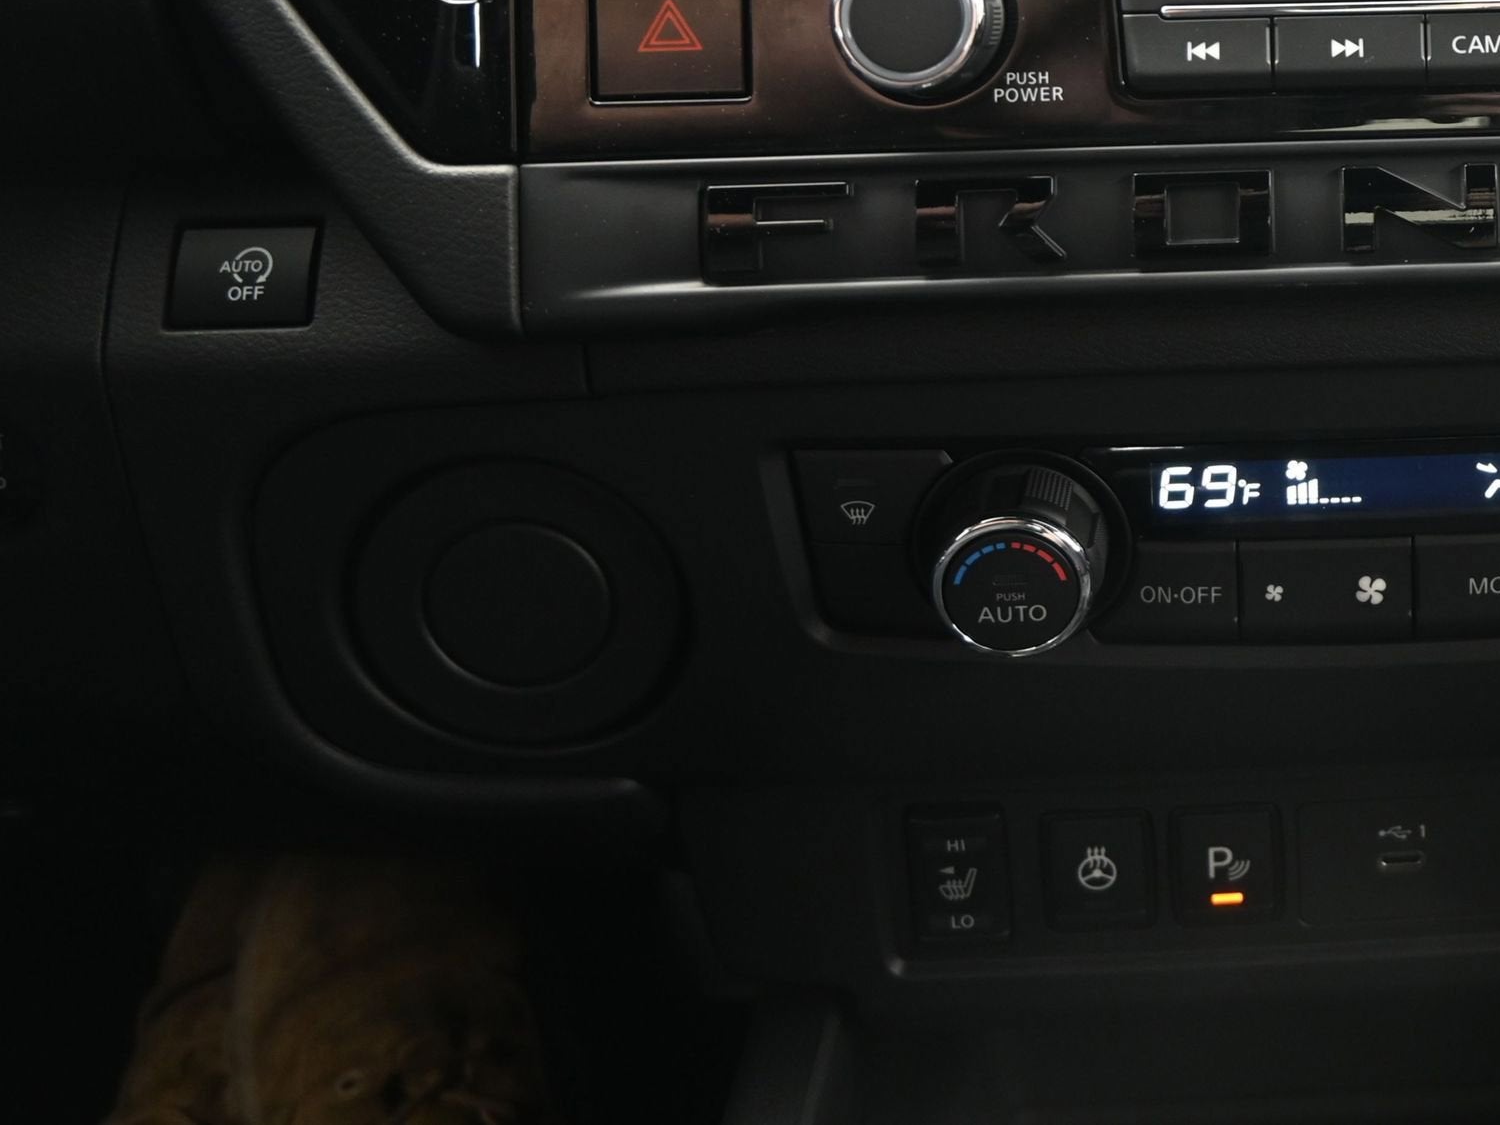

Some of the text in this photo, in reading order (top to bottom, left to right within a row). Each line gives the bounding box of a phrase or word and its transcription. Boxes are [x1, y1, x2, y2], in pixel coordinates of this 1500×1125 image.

[1006, 71, 1049, 85] PUSH
[994, 86, 1064, 104] POWER
[219, 260, 263, 273] AUTO
[227, 285, 265, 301] OFF
[996, 592, 1026, 602] PUSH
[978, 604, 1047, 623] AUTO
[946, 839, 966, 852] HI
[951, 914, 975, 929] LO
